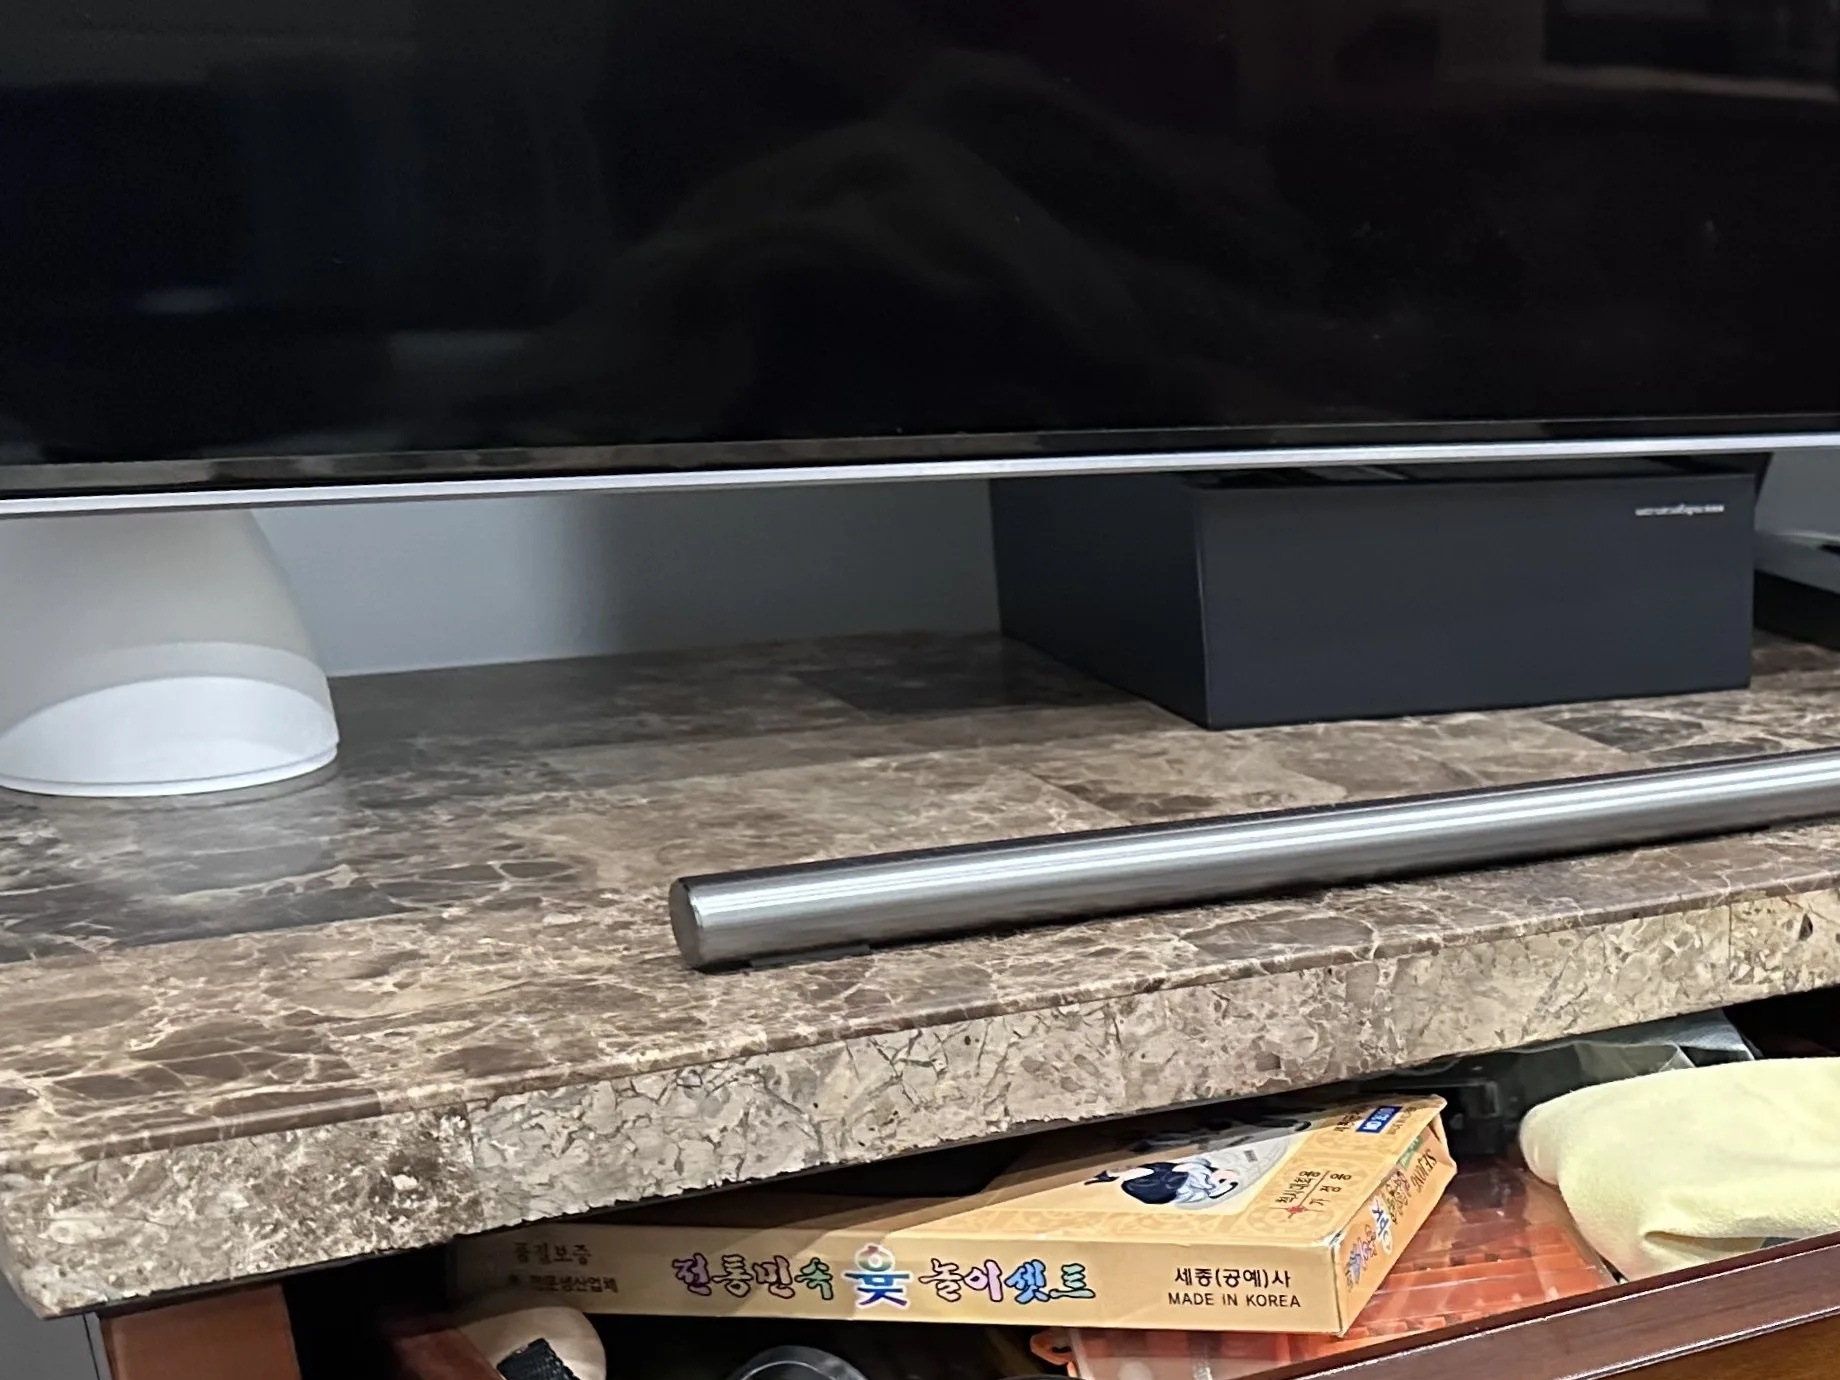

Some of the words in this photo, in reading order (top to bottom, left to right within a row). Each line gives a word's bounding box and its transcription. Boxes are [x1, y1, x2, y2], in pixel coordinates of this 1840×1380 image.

[672, 1252, 834, 1301] 전통민속
[844, 1244, 912, 1308] 윷
[919, 1258, 1097, 1305] 놀이셋트
[1174, 1267, 1291, 1288] 세종(공예)사
[1168, 1292, 1214, 1306] MADE
[1222, 1294, 1238, 1306] IN
[1246, 1294, 1301, 1307] KOREA
